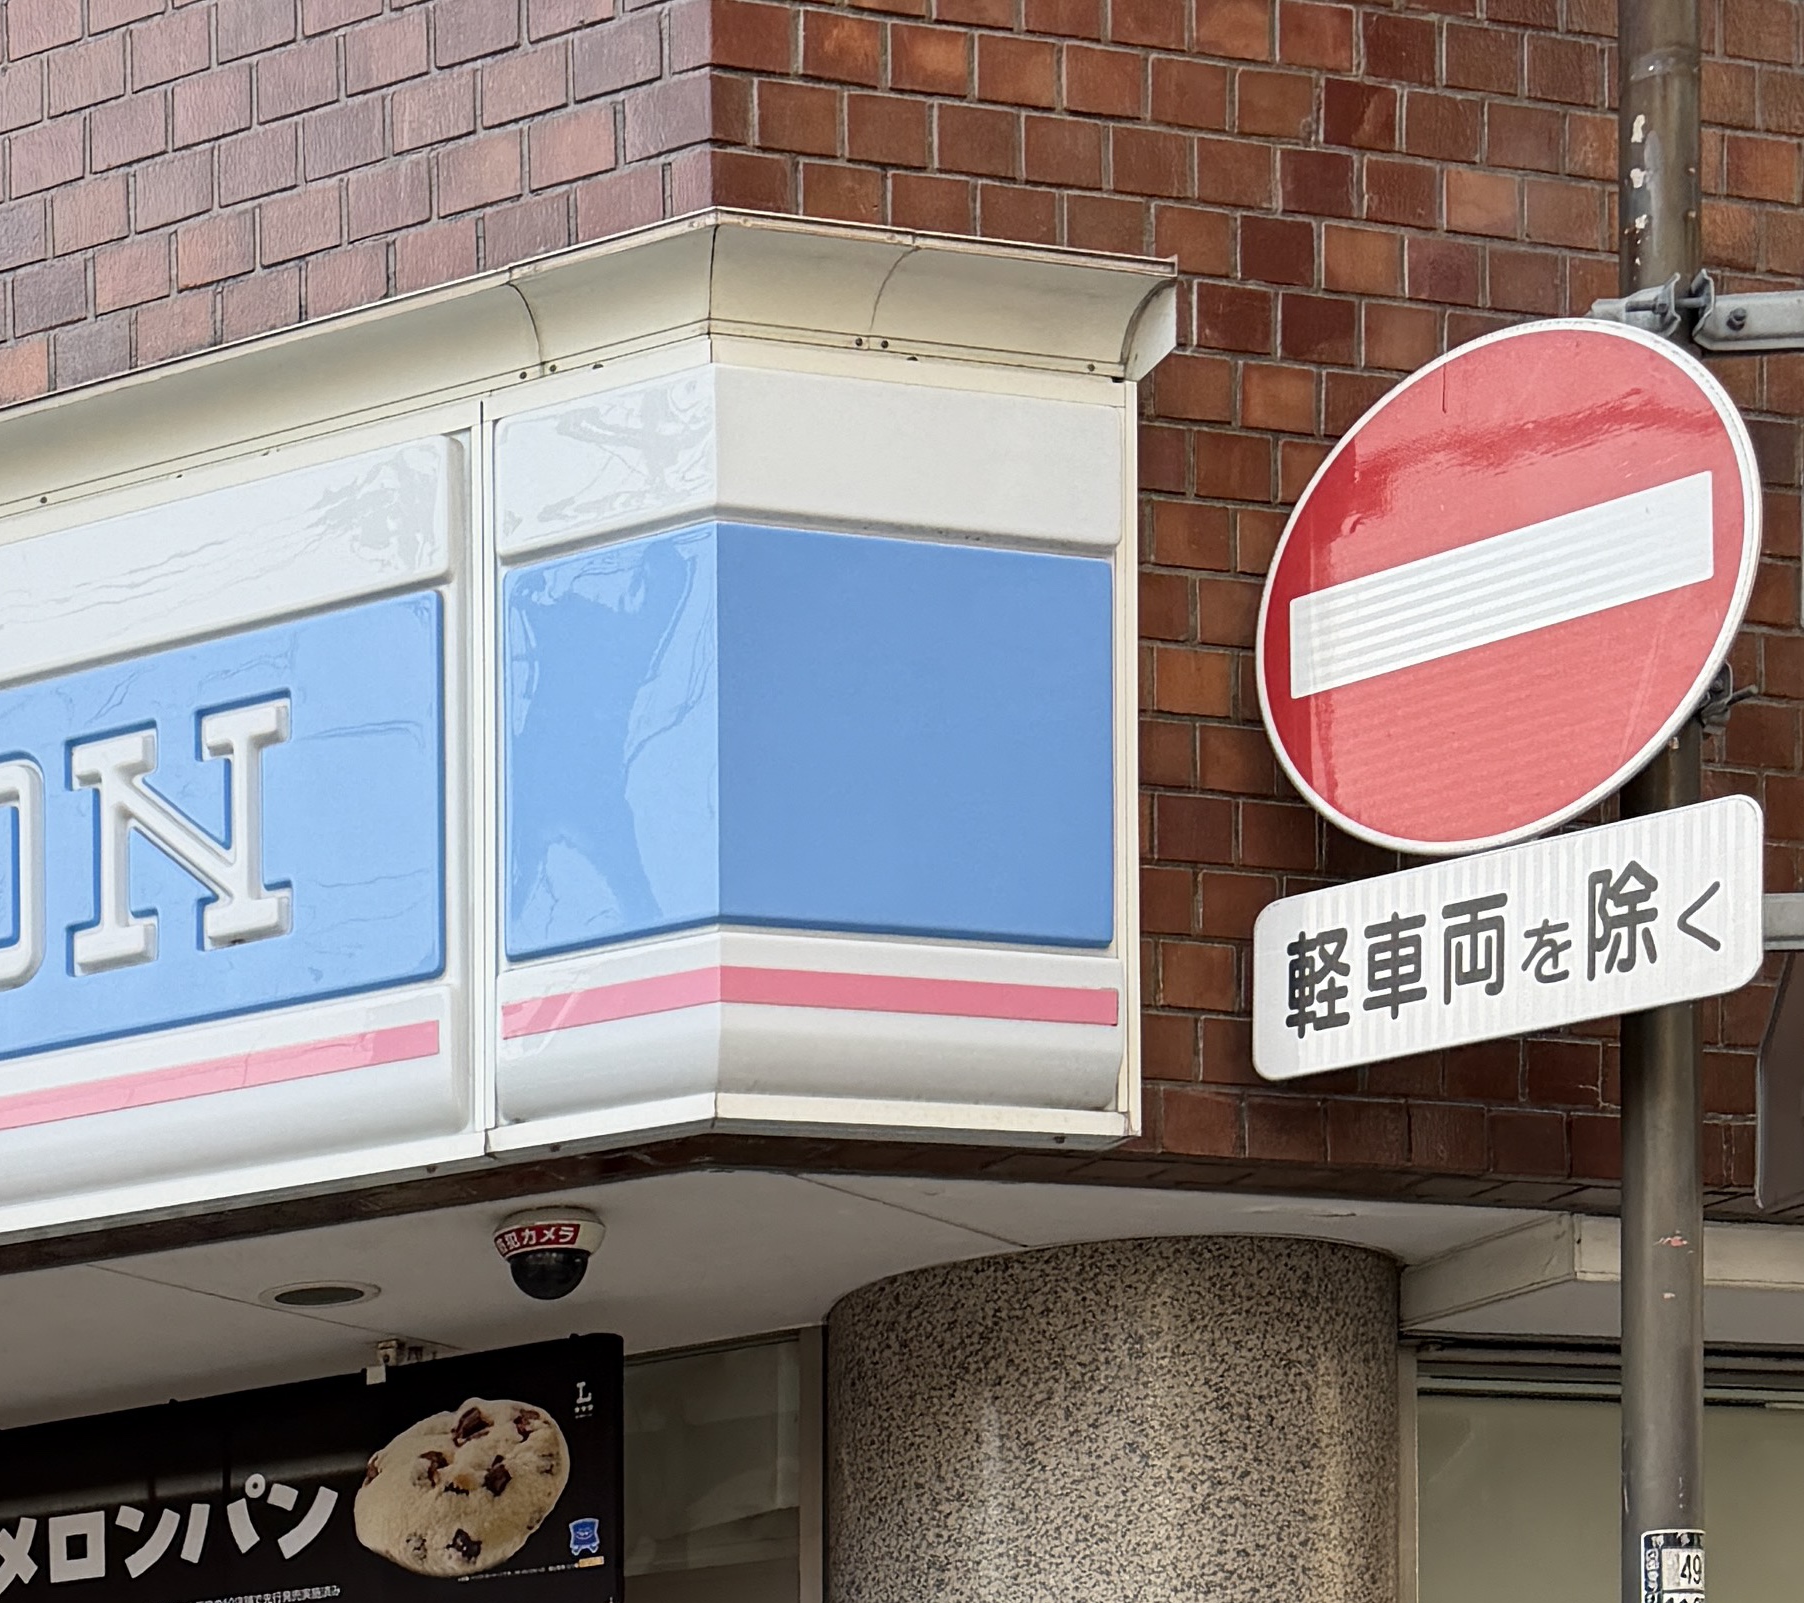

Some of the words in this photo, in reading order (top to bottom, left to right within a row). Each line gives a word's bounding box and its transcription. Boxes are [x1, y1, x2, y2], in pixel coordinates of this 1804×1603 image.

[1285, 859, 1722, 1039] 軽車両を除く
[496, 1226, 575, 1254] 防犯カメラ
